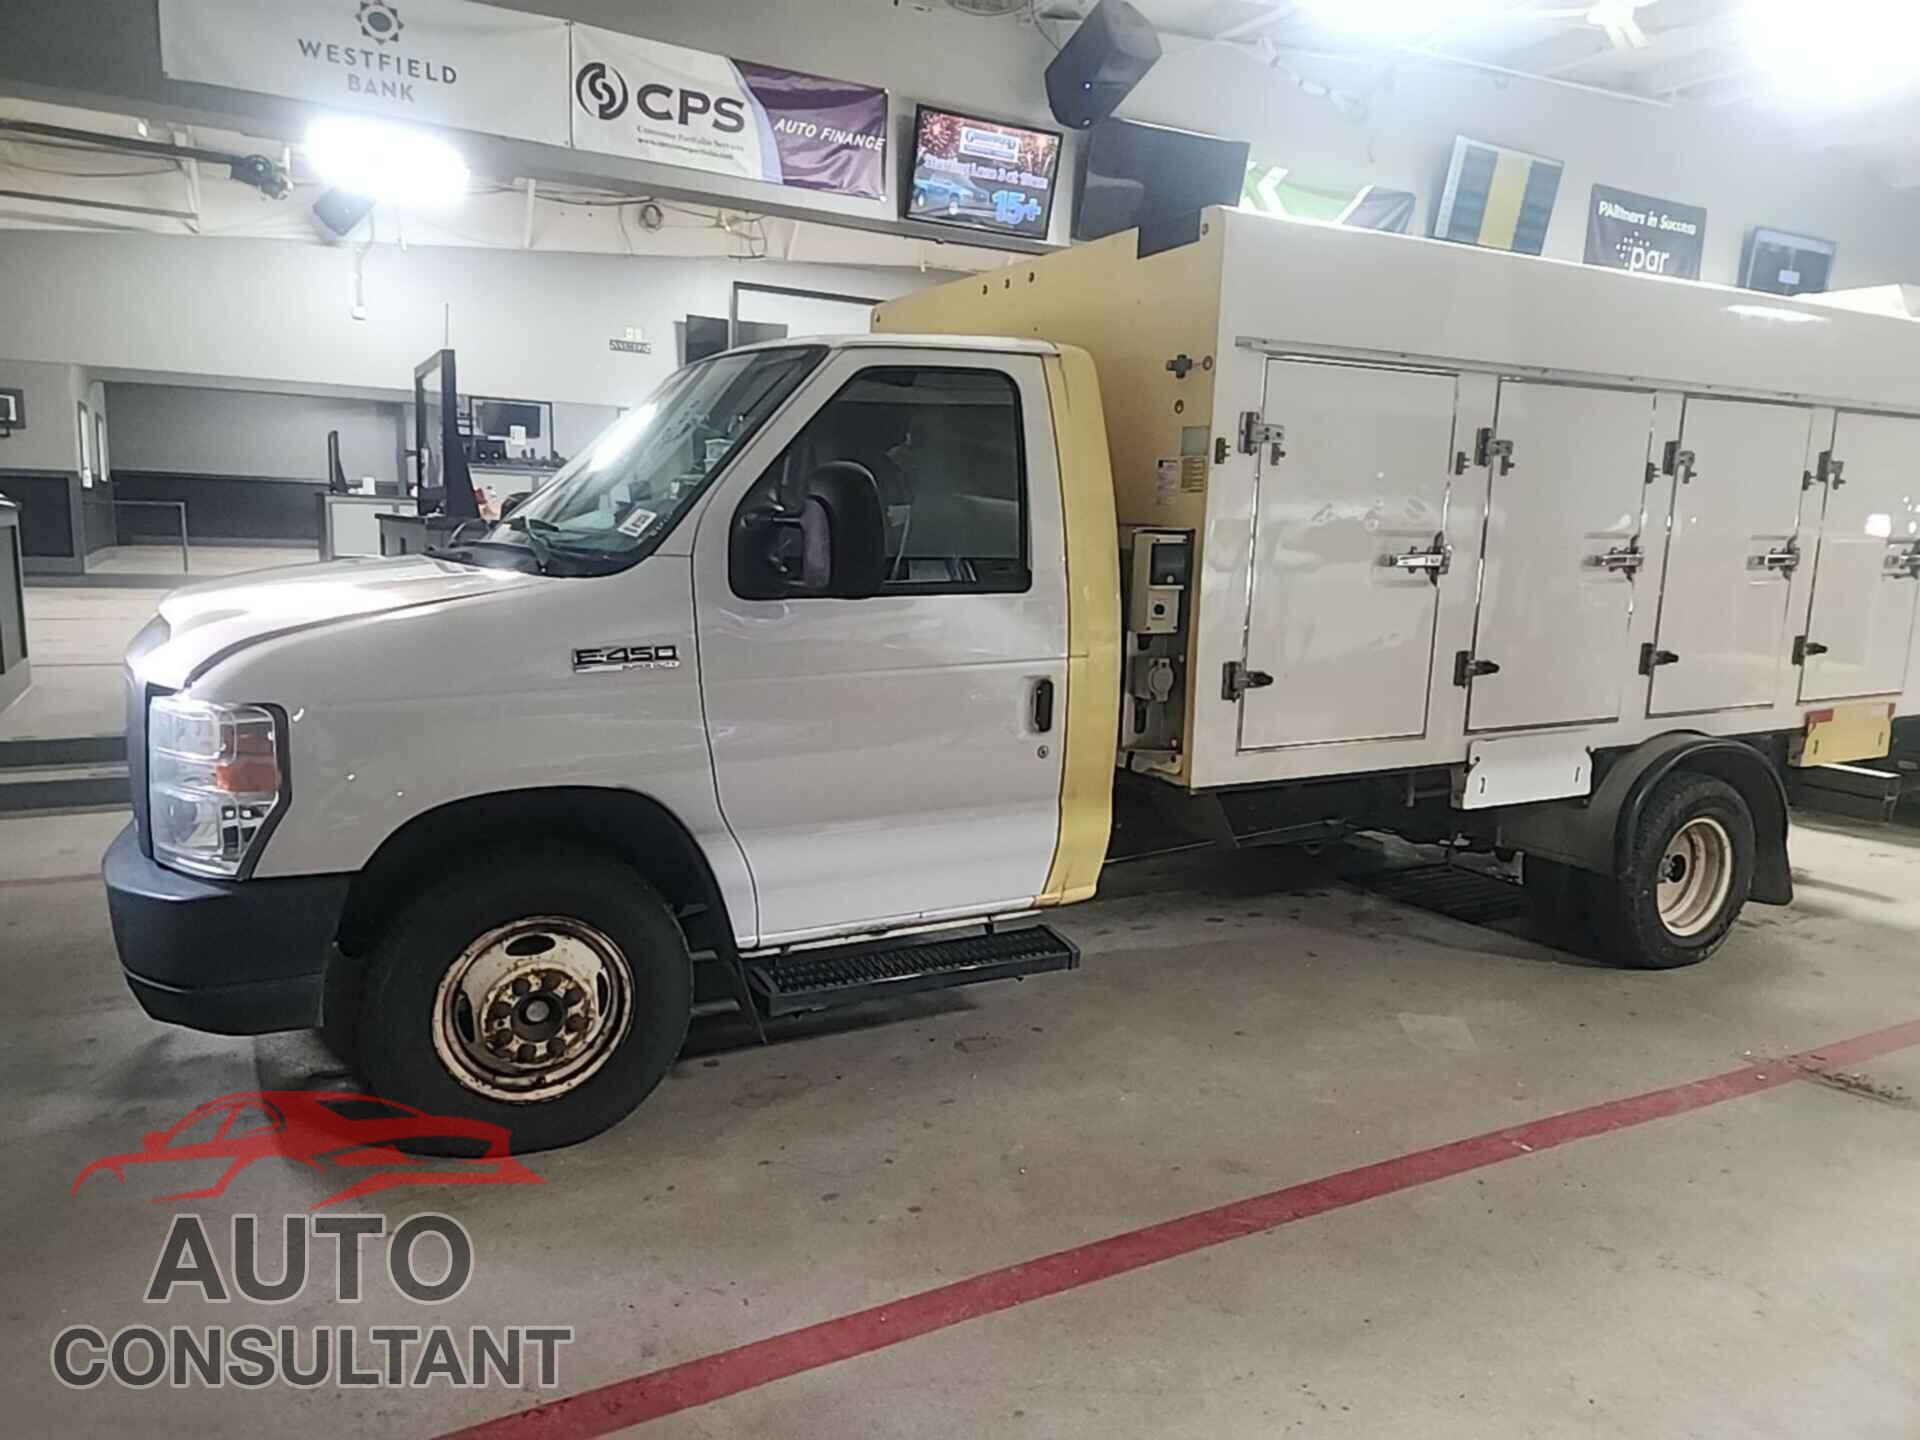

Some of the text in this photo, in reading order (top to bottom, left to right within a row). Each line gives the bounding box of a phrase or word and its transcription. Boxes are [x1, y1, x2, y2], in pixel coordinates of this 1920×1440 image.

[297, 37, 457, 84] WESTFIELD
[347, 73, 415, 103] BANK
[636, 83, 745, 133] CPS
[774, 118, 886, 151] AUTO FINANCE
[1647, 210, 1658, 228] in
[1659, 214, 1697, 236] Success
[1629, 246, 1670, 273] par
